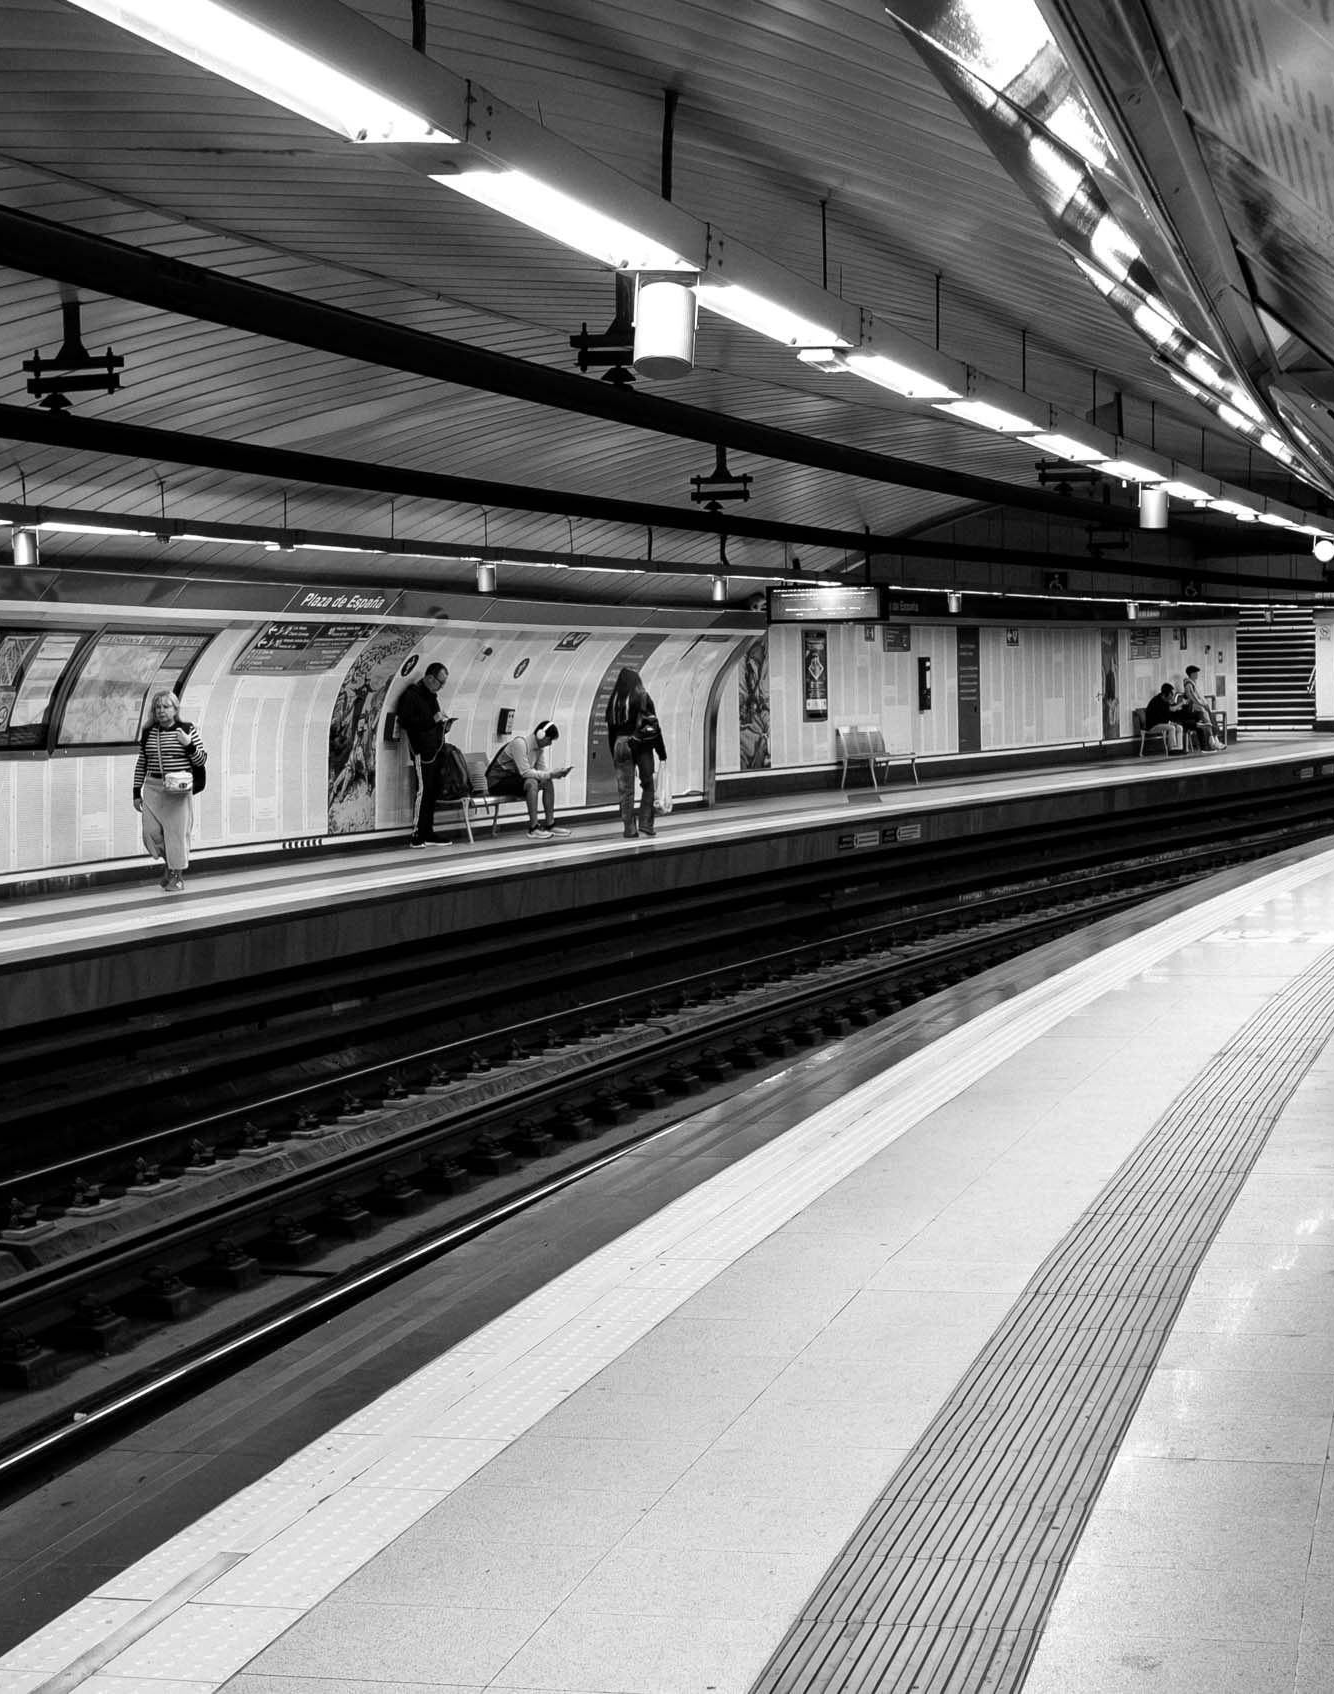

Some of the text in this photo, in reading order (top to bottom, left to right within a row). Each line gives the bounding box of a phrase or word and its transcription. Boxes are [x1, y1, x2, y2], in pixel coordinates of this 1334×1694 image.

[300, 593, 386, 611] Plaza de España
